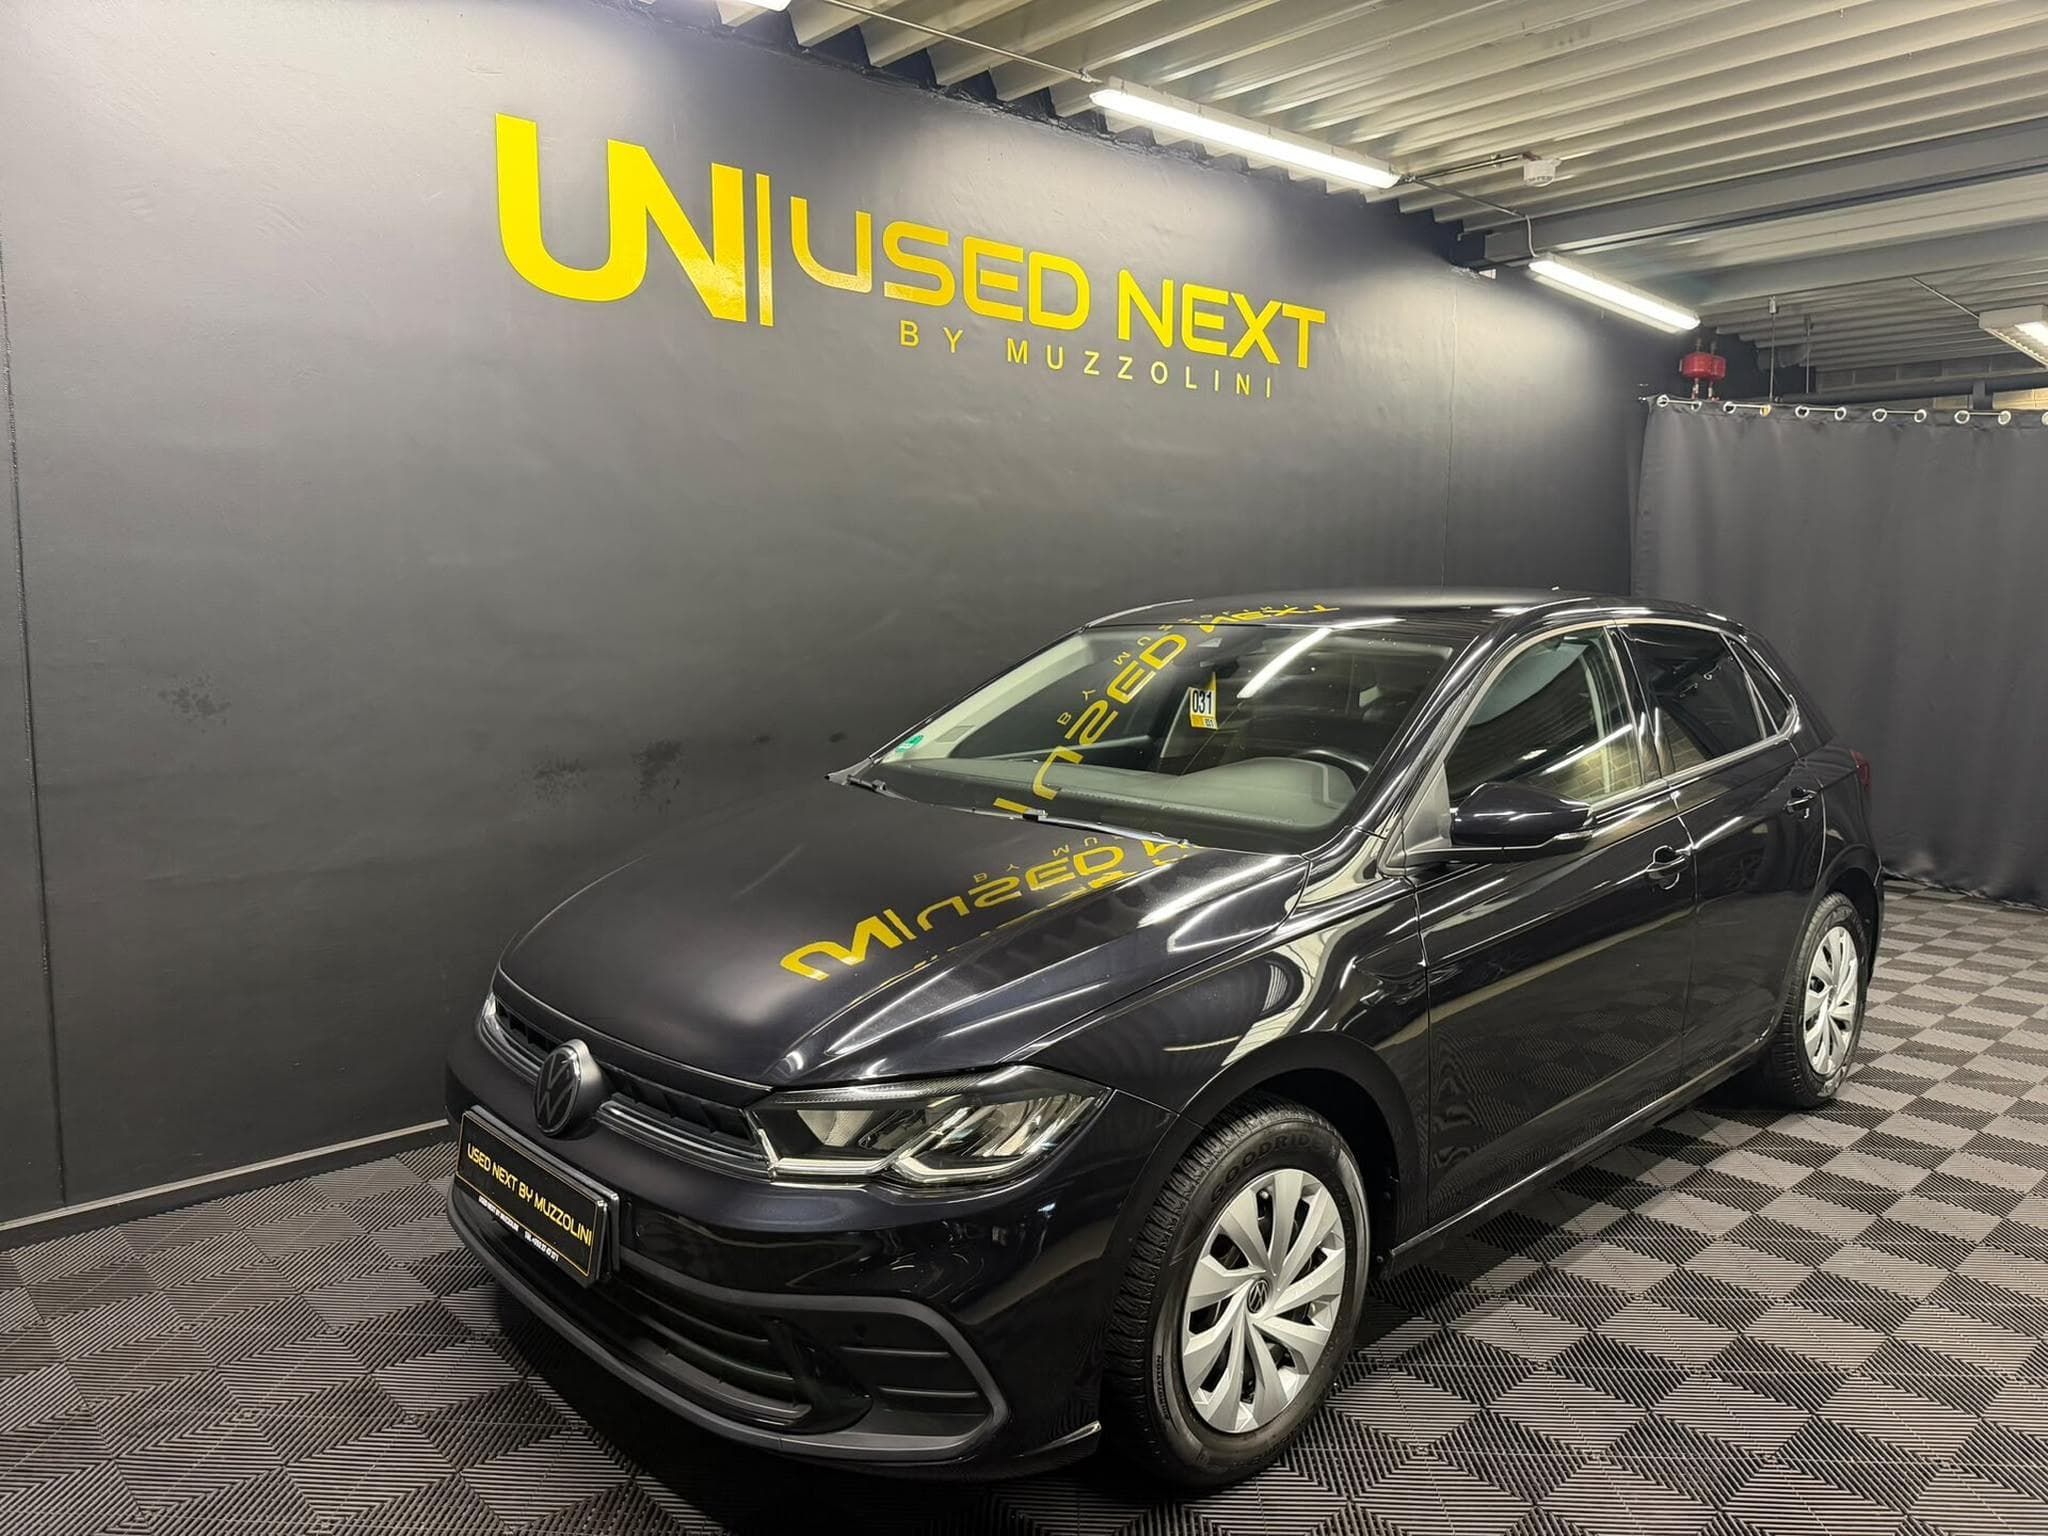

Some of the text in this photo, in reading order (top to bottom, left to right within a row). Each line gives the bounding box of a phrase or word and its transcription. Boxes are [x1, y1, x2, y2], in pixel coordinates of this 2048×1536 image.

[789, 195, 1093, 333] USED
[1116, 267, 1329, 372] NEXT
[899, 319, 1273, 400] BY MUZZOLINI
[1192, 690, 1212, 714] 031
[466, 1142, 492, 1173] USED
[491, 1157, 519, 1193] NEXT
[518, 1181, 534, 1203] BY
[533, 1192, 593, 1248] MUZZOLINI
